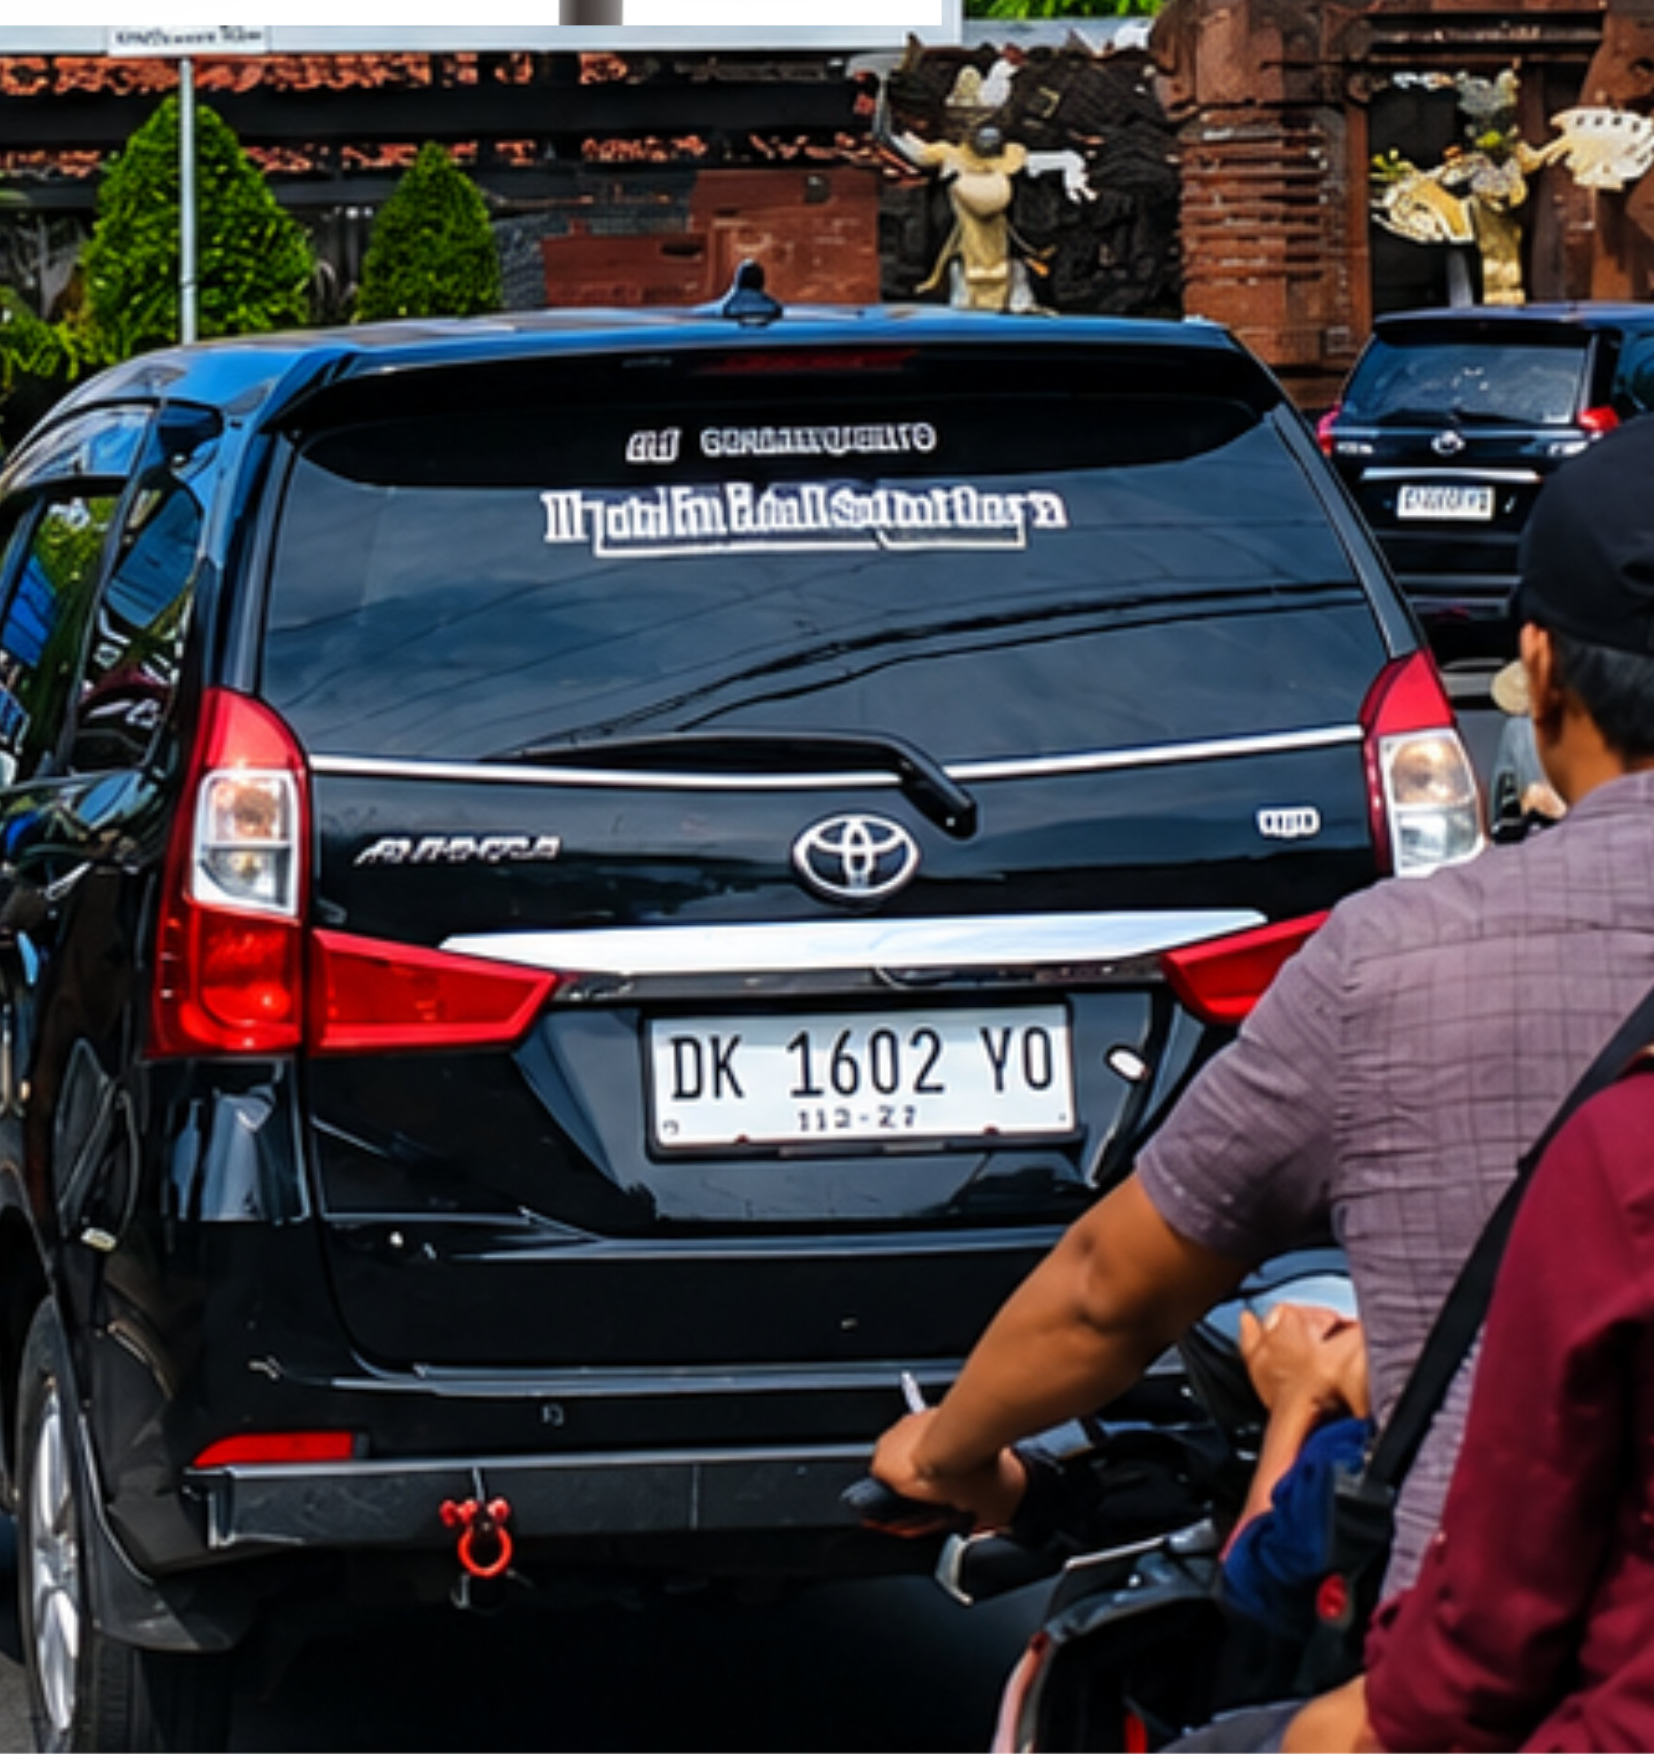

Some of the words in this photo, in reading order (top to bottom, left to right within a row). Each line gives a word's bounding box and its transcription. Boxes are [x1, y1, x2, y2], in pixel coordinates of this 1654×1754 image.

[668, 1033, 745, 1100] DK
[784, 1026, 946, 1099] 1602
[979, 1024, 1054, 1093] YO
